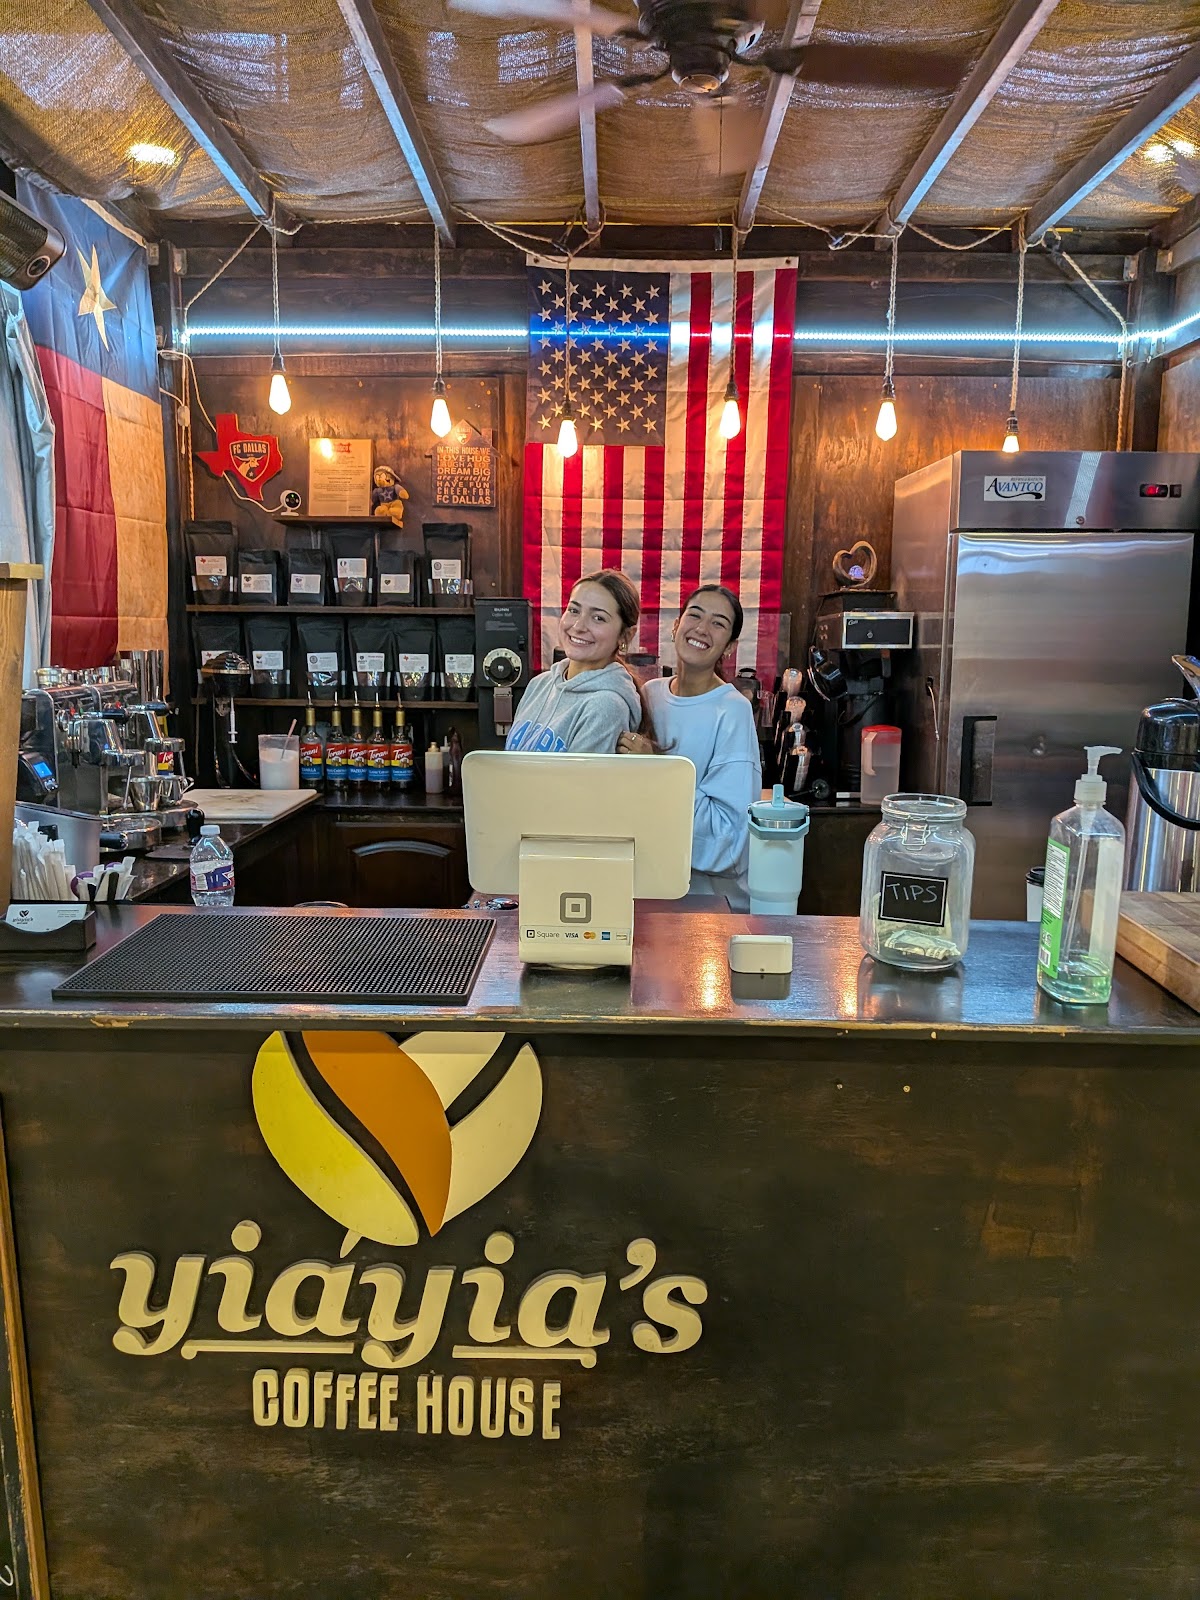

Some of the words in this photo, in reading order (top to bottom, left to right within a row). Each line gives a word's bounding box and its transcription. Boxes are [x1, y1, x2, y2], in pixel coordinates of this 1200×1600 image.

[233, 444, 241, 455] FC
[243, 442, 267, 454] DALLAS
[461, 447, 479, 455] HOUSE
[473, 468, 491, 476] BIG
[472, 488, 490, 496] FOR
[986, 477, 1043, 495] AVANTCO
[436, 495, 449, 503] FC
[452, 495, 491, 504] DALLAS
[326, 747, 347, 759] Torani
[369, 748, 389, 761] Torani
[886, 883, 938, 903] TIPS
[109, 1219, 709, 1369] yiayia's
[252, 1368, 399, 1432] COFFEE
[416, 1372, 563, 1440] HOUSE
